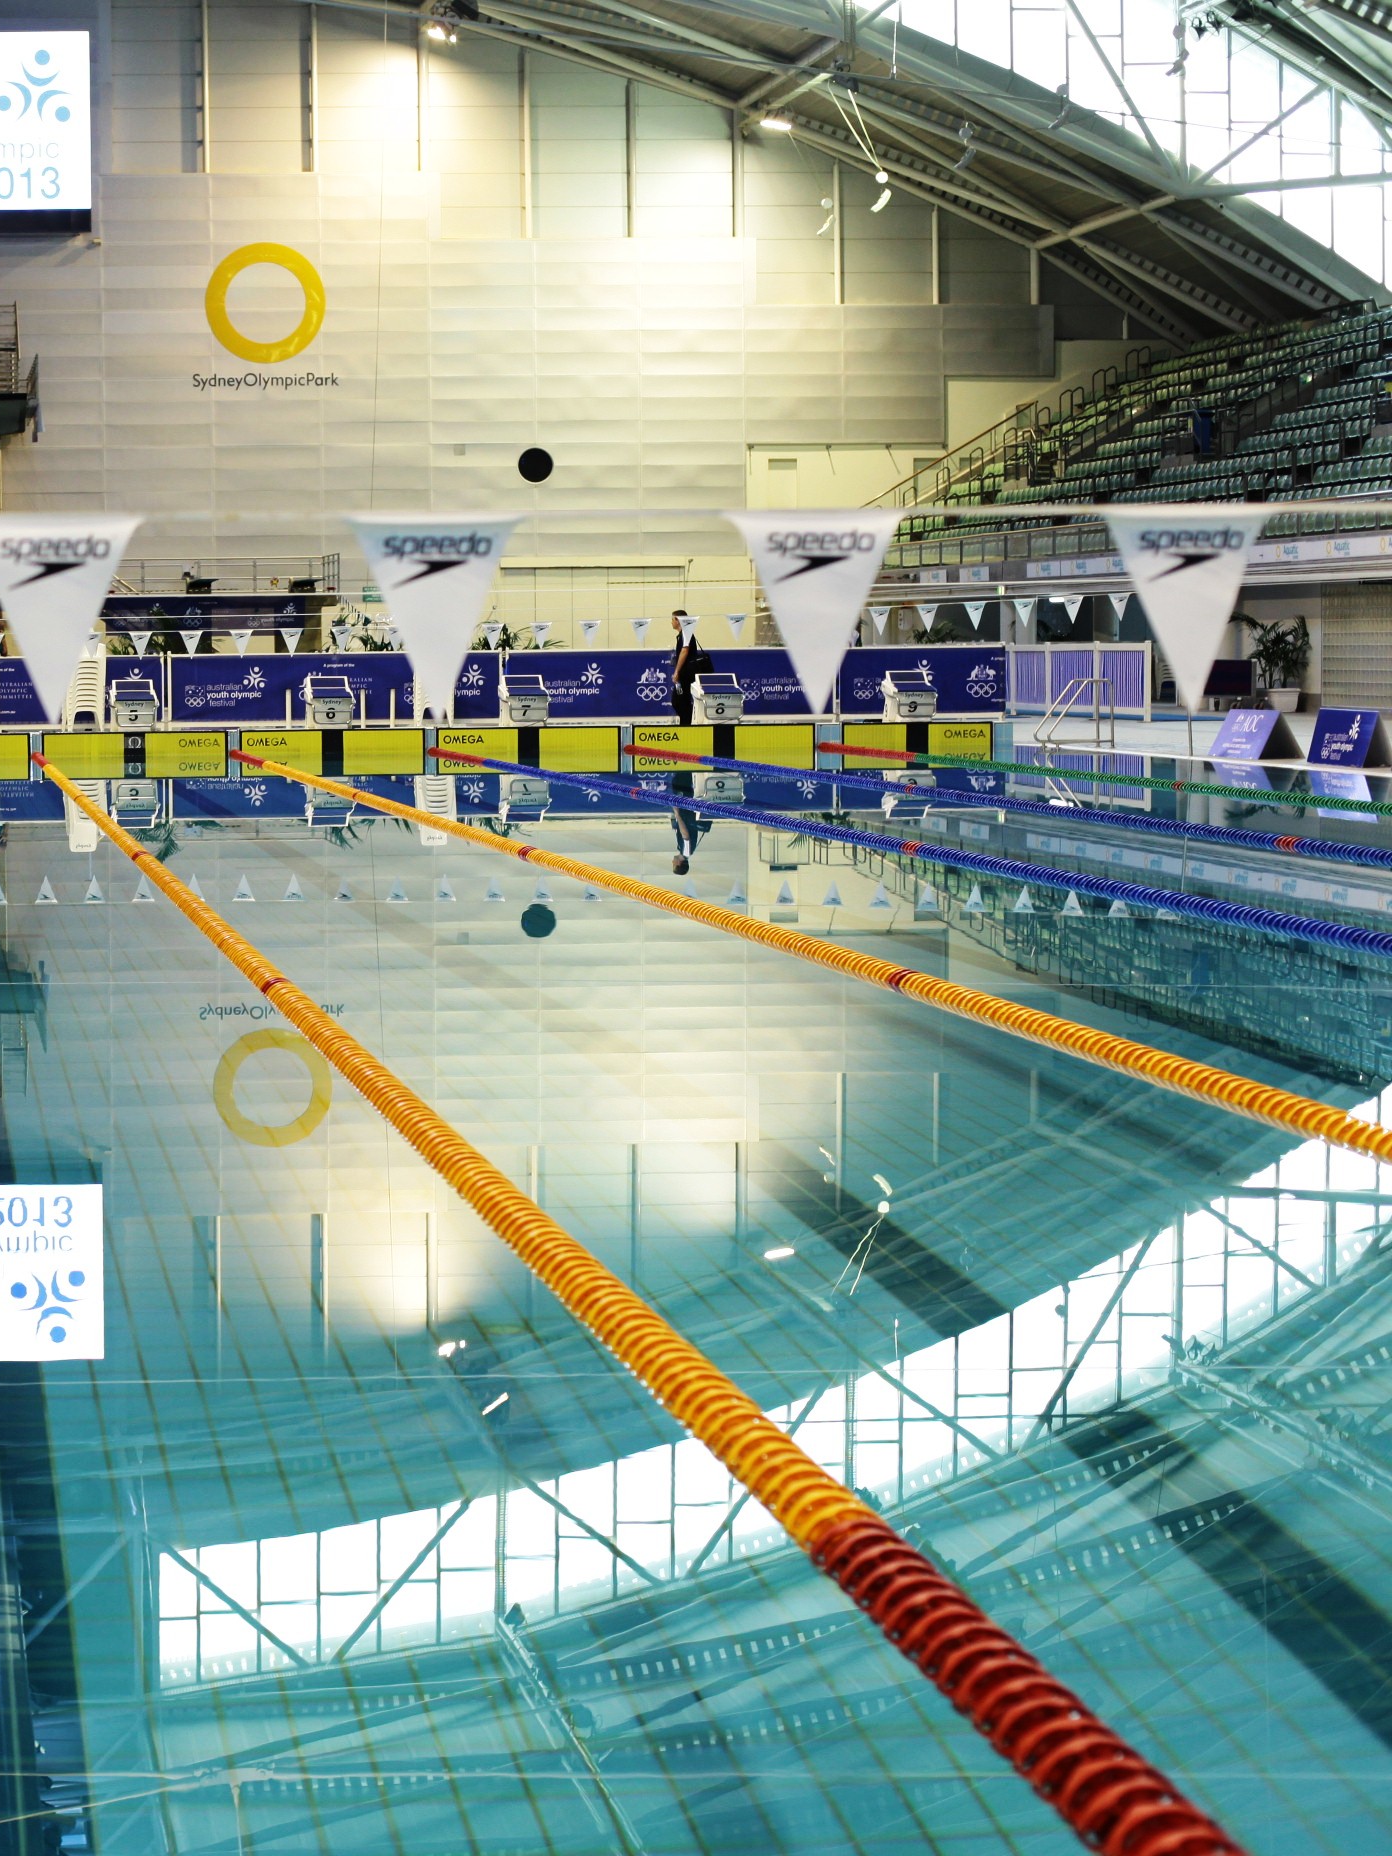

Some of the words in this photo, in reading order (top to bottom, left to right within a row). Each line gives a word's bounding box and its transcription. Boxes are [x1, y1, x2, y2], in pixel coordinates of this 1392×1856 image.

[192, 372, 339, 391] SydneyOlympicPark
[768, 530, 875, 557] speedo
[1139, 527, 1245, 555] speedo
[0, 534, 110, 563] speedo
[383, 532, 493, 562] speedo
[207, 683, 242, 691] australian
[569, 687, 600, 696] olympic
[761, 685, 783, 693] youth
[785, 685, 804, 693] olym
[207, 691, 229, 699] youth
[231, 691, 262, 699] olympic
[454, 688, 480, 696] lympic
[764, 692, 790, 700] festival
[209, 699, 236, 707] festival
[908, 701, 918, 713] 9
[129, 710, 139, 721] 5
[326, 707, 336, 719] 6
[521, 705, 531, 717] 7
[1240, 714, 1264, 733] AOC
[639, 732, 680, 741] OMEGA
[944, 729, 986, 738] OMEGA
[178, 738, 220, 747] OMEGA
[247, 737, 288, 746] OMEGA
[443, 735, 484, 744] OMEGA
